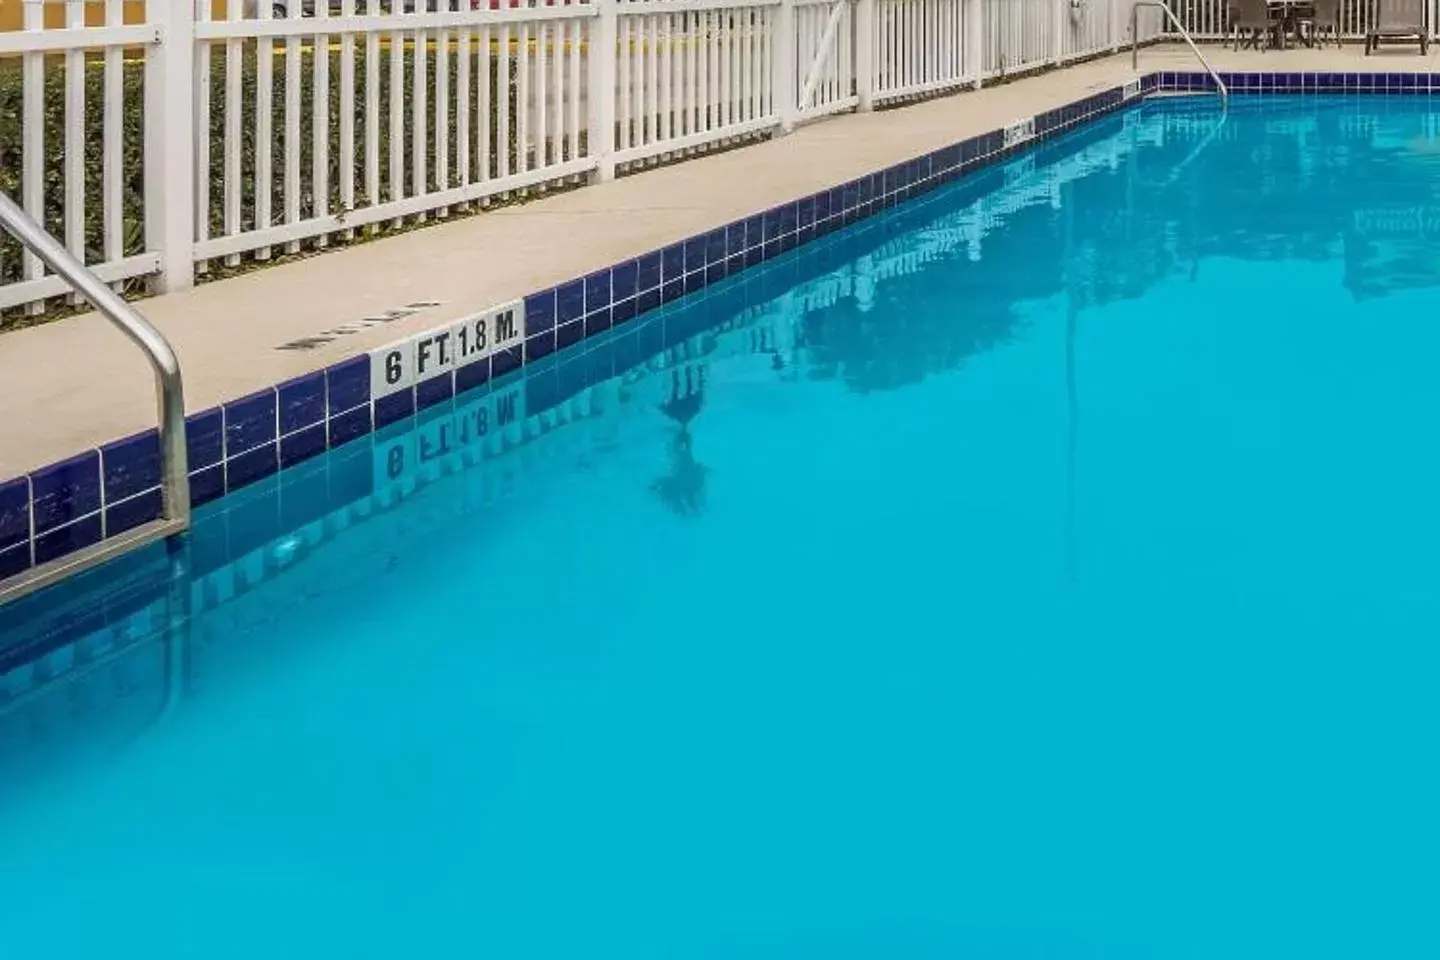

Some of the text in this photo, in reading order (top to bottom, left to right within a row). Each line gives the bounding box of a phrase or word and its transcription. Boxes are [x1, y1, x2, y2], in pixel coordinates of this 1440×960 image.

[385, 350, 402, 385] 6
[417, 335, 450, 373] FT.
[458, 319, 487, 357] 1.8
[494, 309, 518, 344] M.
